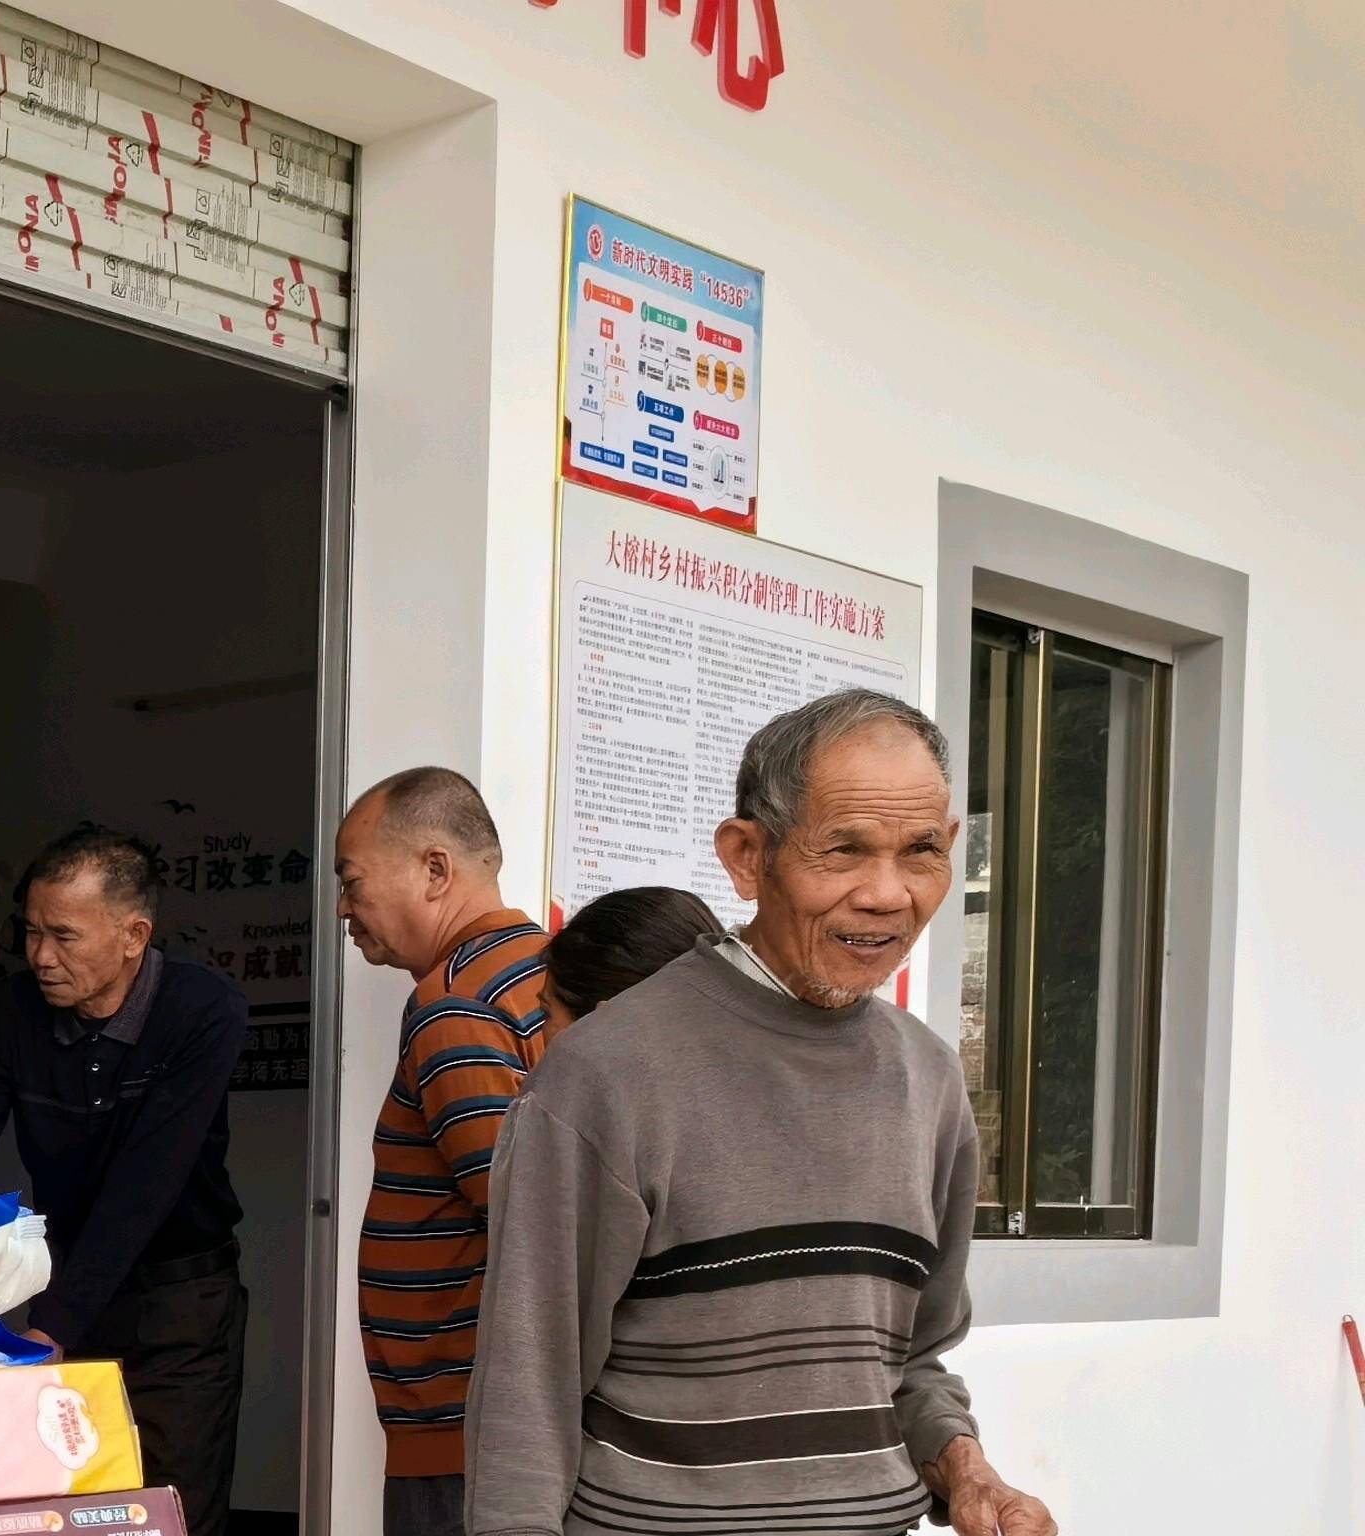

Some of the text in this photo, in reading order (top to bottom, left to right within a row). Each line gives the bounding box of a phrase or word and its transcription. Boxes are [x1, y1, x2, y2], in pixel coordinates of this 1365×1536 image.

[606, 530, 886, 641] 大榕村乡村振兴积分制管理工作实施方案
[203, 832, 252, 854] Study
